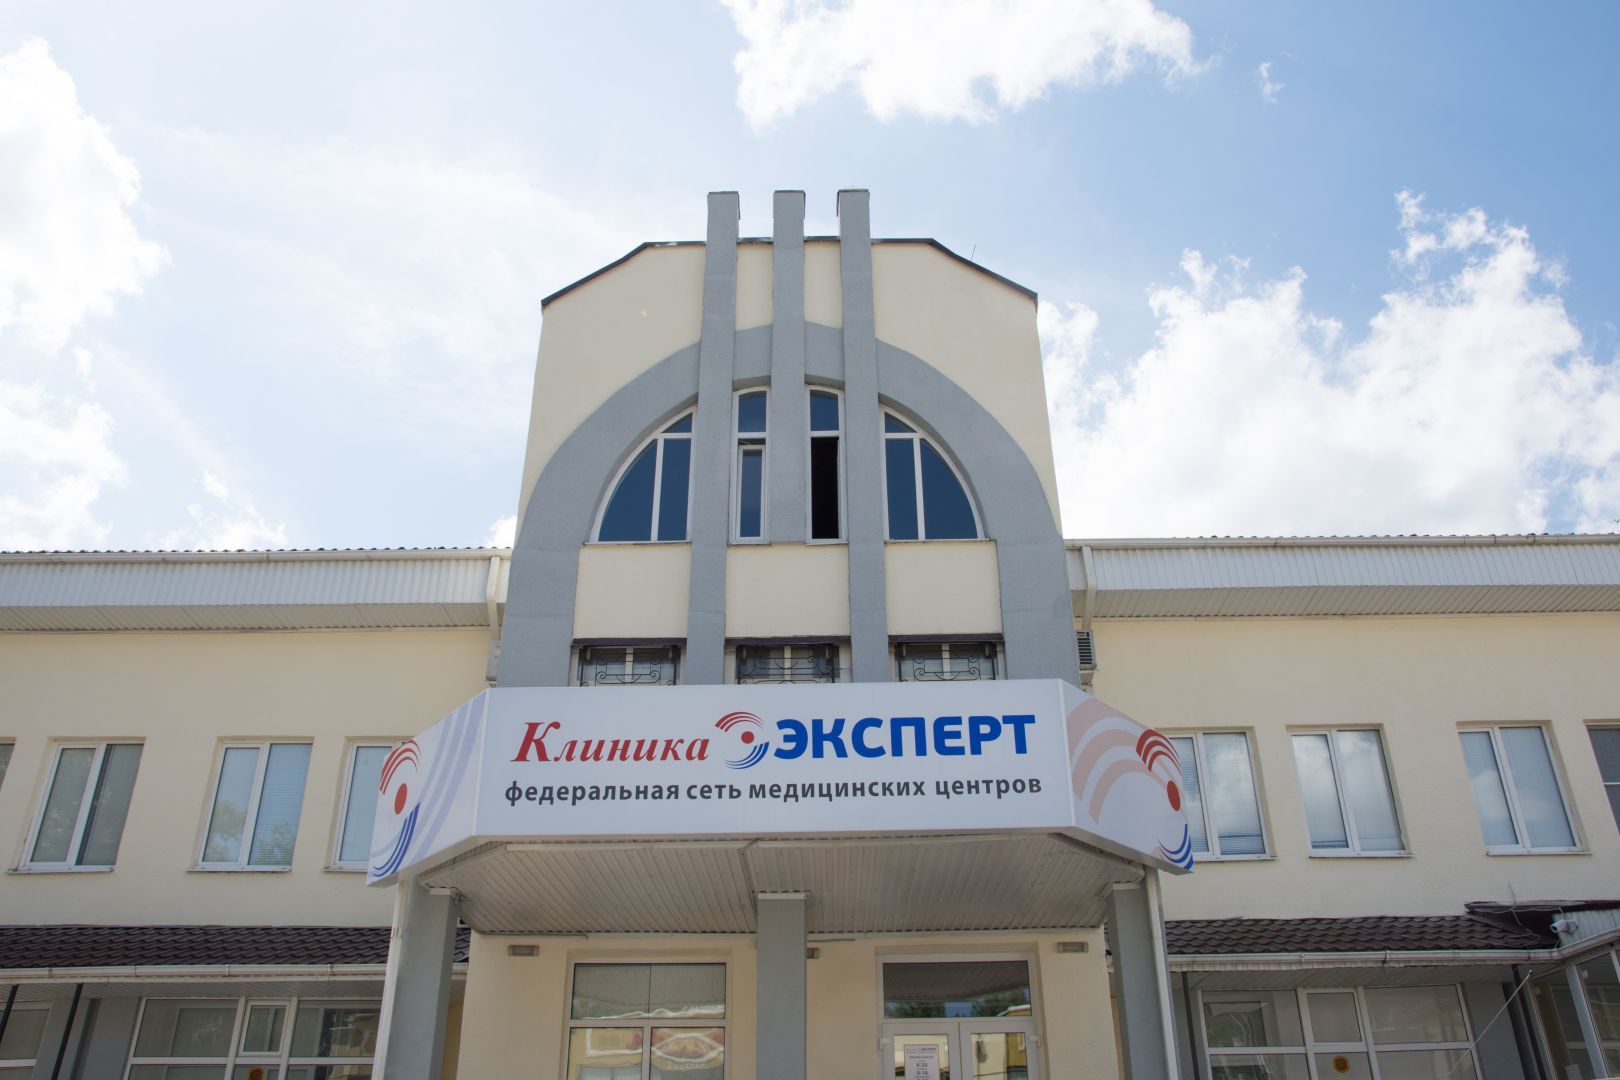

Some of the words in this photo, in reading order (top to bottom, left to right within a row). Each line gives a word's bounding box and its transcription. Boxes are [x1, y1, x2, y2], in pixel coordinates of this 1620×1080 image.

[511, 721, 710, 763] Клиника
[774, 714, 1036, 761] ЭКСПЕРТ
[505, 781, 680, 807] федеральная
[686, 784, 742, 800] сеть
[748, 780, 926, 803] медицинских
[935, 778, 1042, 800] центров
